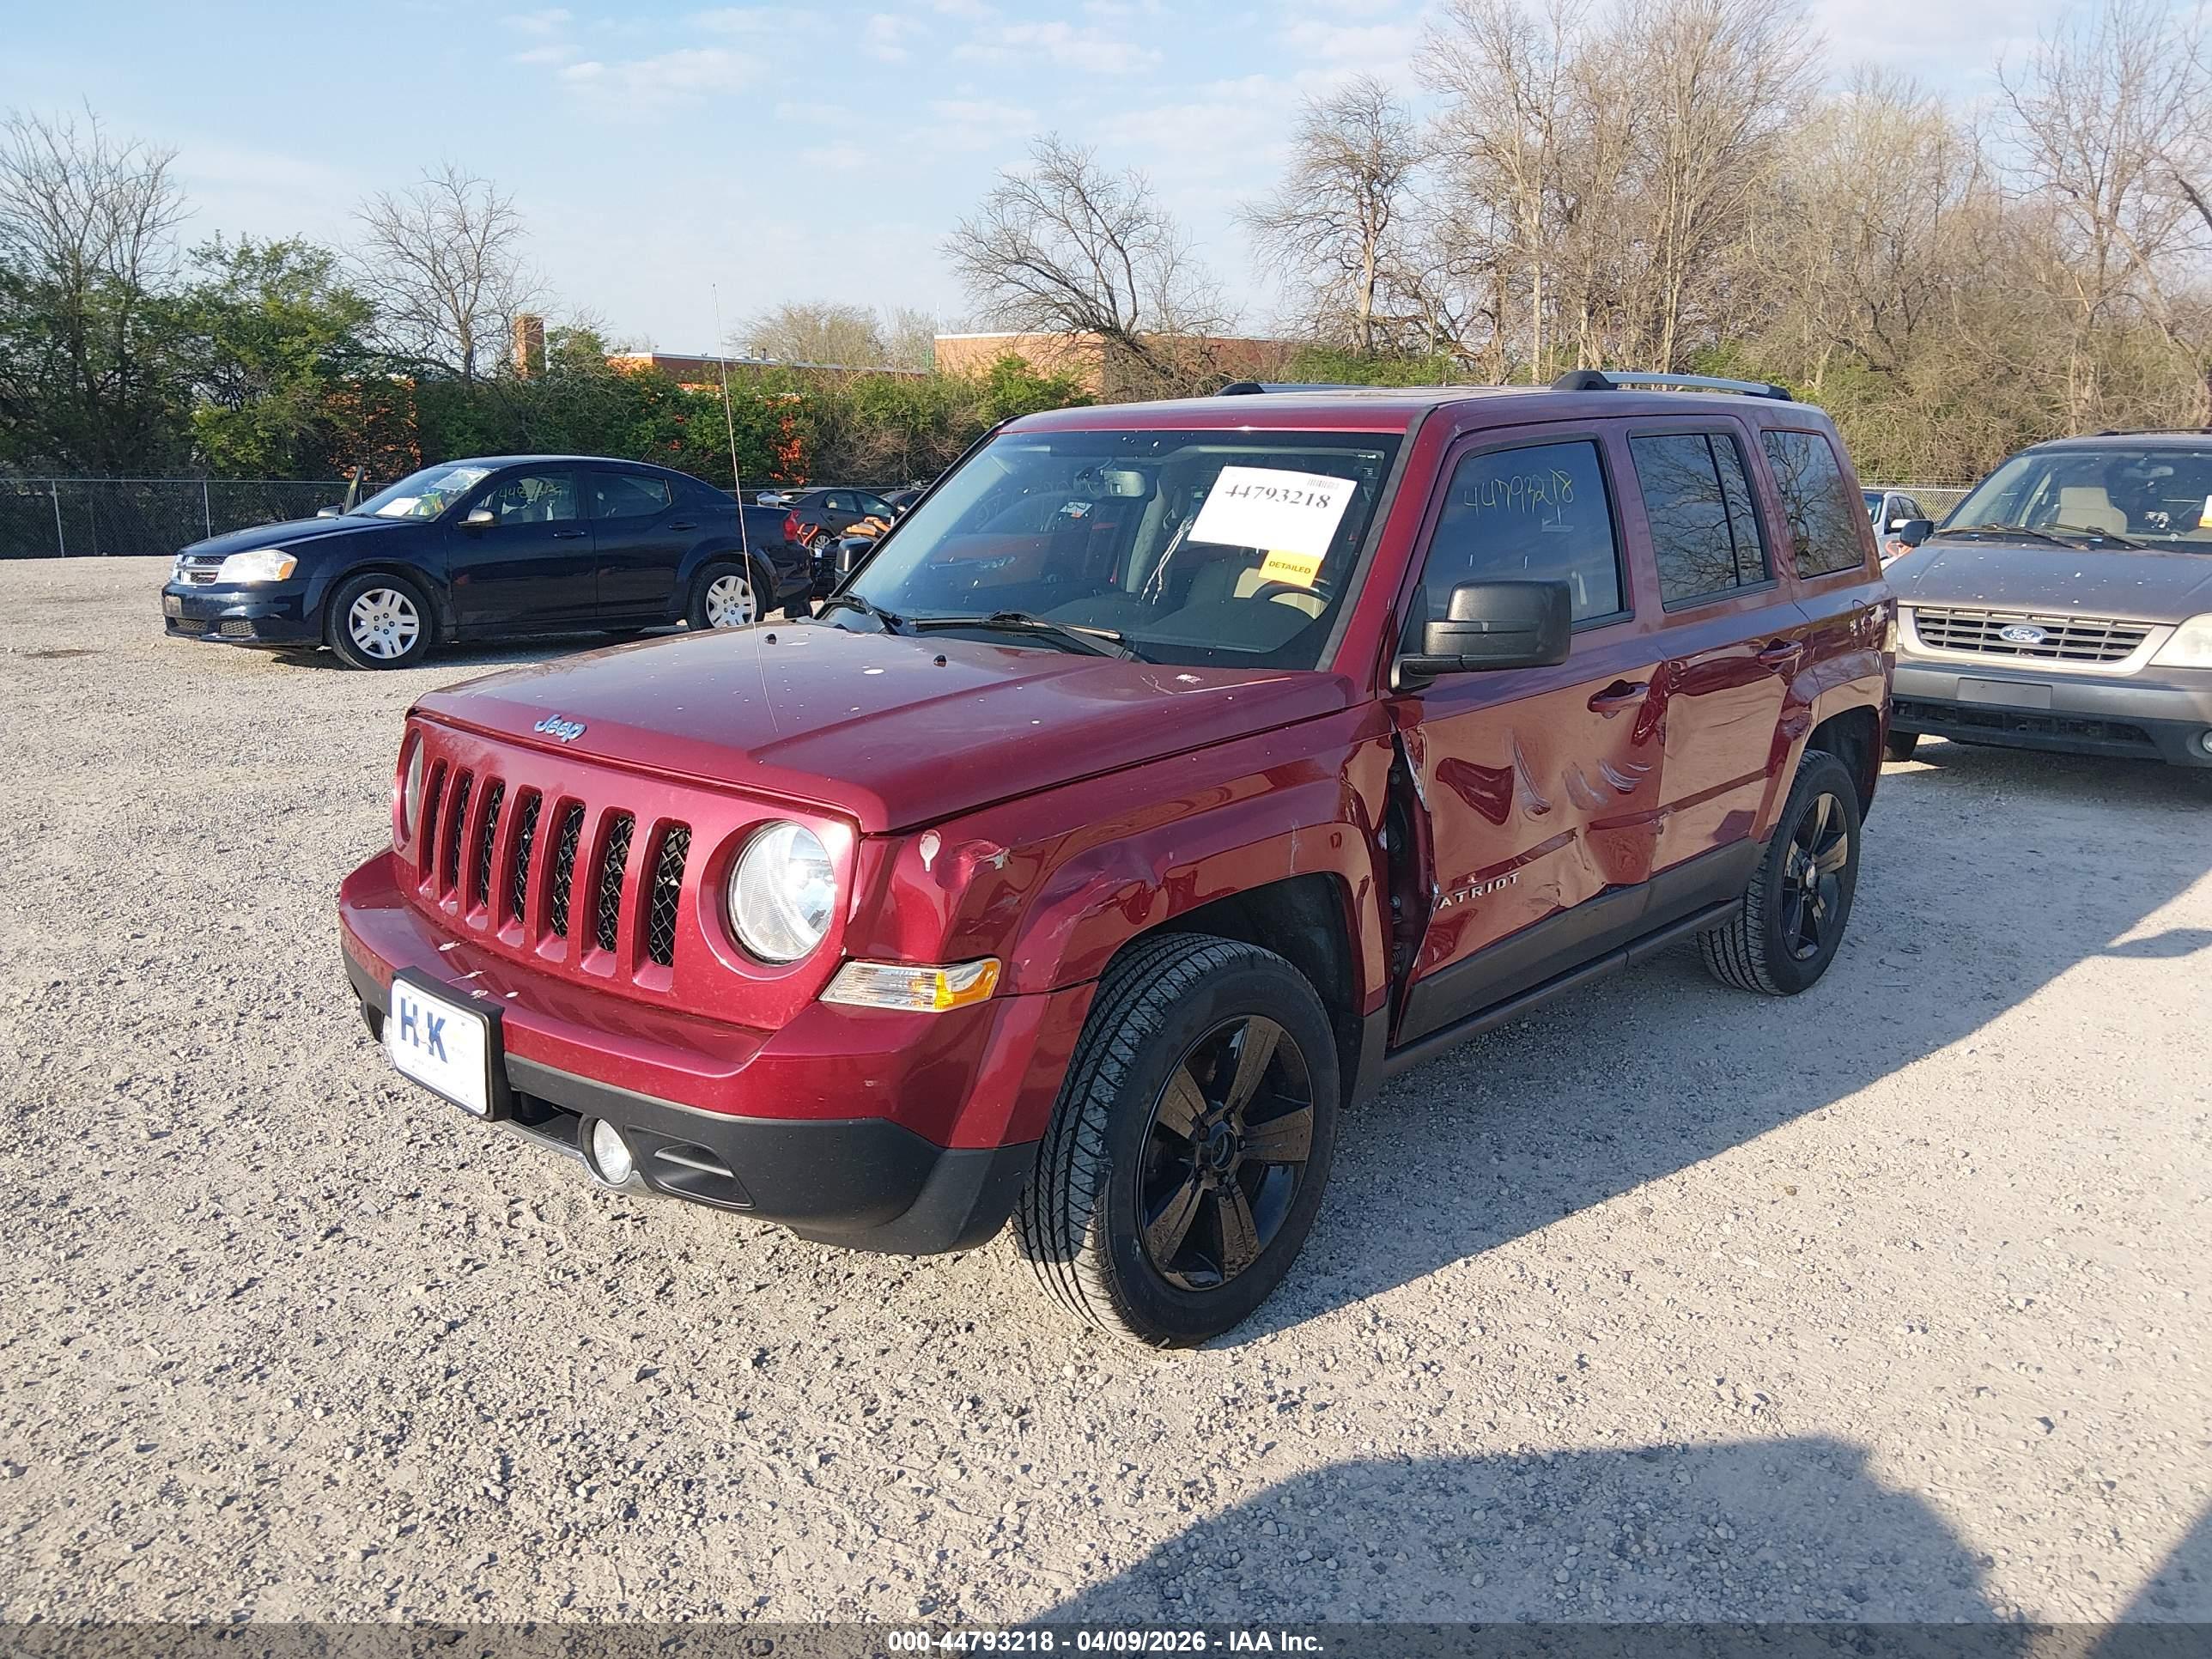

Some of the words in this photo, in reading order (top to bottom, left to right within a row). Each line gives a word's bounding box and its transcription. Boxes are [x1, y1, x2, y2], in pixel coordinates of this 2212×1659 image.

[1225, 484, 1330, 509] 44793218
[1464, 468, 1574, 515] 44793218
[1268, 560, 1311, 574] DETAILED
[534, 714, 586, 743] Jeep
